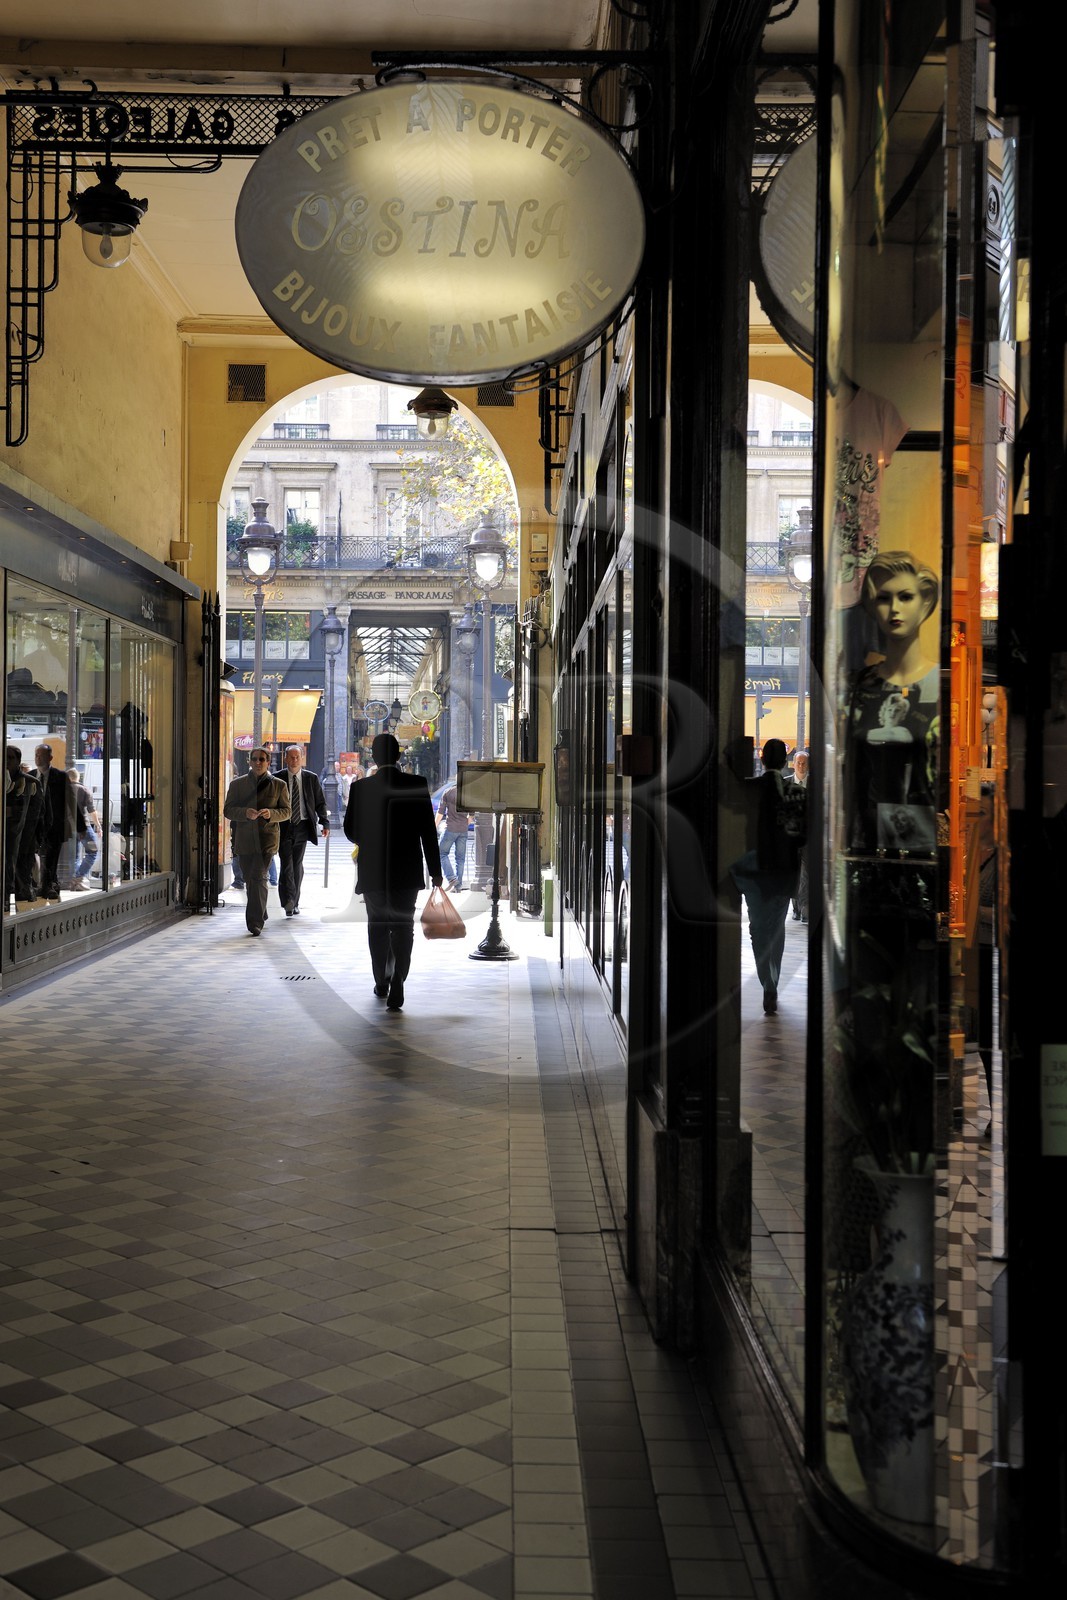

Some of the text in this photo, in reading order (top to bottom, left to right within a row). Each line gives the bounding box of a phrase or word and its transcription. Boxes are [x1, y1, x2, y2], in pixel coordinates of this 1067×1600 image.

[297, 107, 382, 173] PRET
[406, 94, 431, 134] A
[456, 98, 592, 178] PORTER
[272, 269, 613, 357] BIJOUX FANTAISIE
[347, 591, 386, 600] PASSAGE
[395, 591, 454, 600] PANORAMAS
